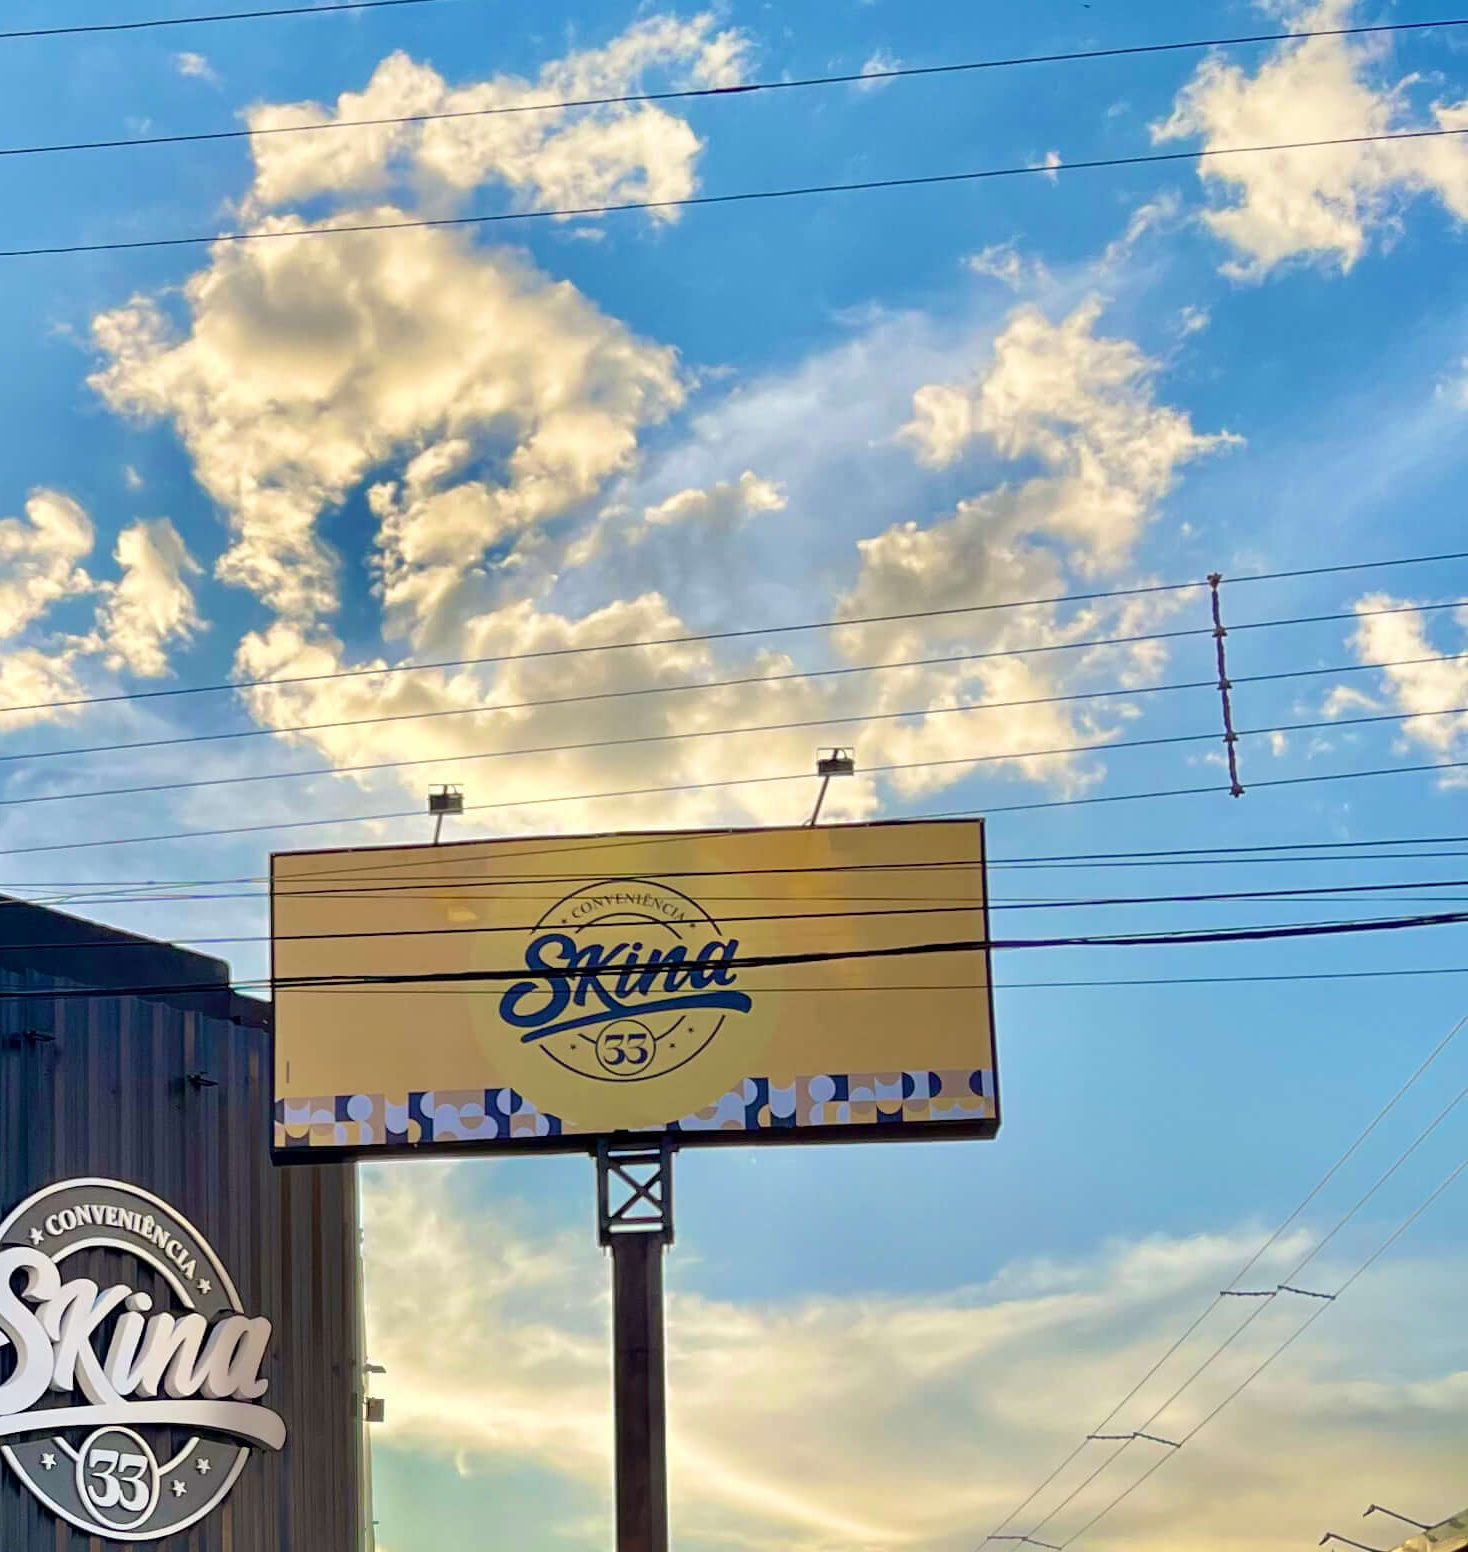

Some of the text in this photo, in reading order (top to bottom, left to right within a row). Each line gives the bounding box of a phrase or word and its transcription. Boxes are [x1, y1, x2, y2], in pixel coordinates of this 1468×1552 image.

[570, 892, 687, 924] CONVENIÊNCIA
[603, 1033, 648, 1066] 33
[43, 1203, 198, 1282] CONVENIÊNCIA
[86, 1448, 151, 1512] 33
